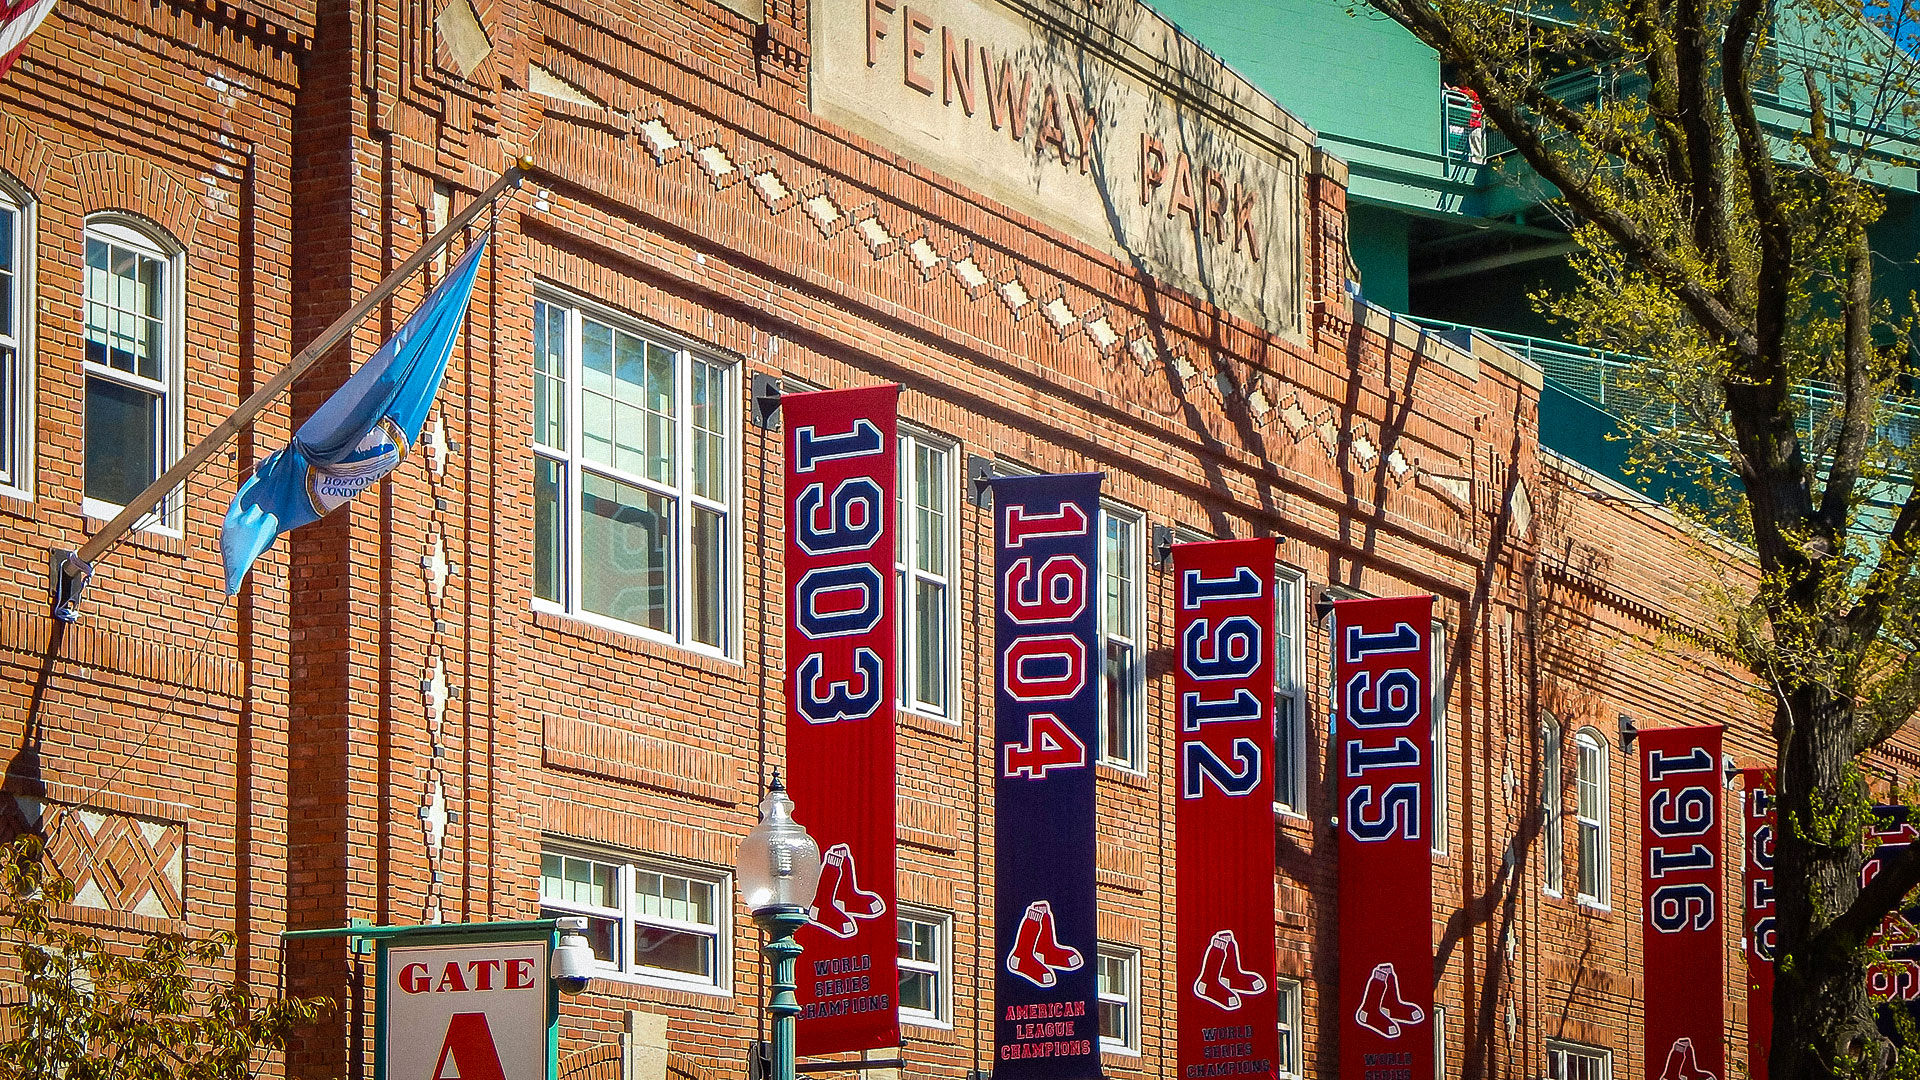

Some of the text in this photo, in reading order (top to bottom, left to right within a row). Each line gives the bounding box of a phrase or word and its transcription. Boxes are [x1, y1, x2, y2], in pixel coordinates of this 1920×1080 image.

[866, 0, 1259, 262] FENWAY PARK
[795, 418, 884, 725] 1903
[1004, 501, 1088, 780] 1904
[1183, 566, 1263, 799] 1912
[1346, 622, 1420, 841] 1915
[1649, 747, 1714, 934] 1916
[814, 954, 871, 976] WORLD
[398, 958, 536, 995] GATE
[815, 975, 870, 997] SERIES
[1005, 1001, 1085, 1021] AMERICAN
[1016, 1021, 1075, 1040] LEAGUE
[1202, 1025, 1253, 1042] WORLD
[432, 1012, 507, 1080] A
[1001, 1039, 1091, 1061] CHAMPIONS
[1203, 1042, 1252, 1060] SERIES
[1187, 1058, 1270, 1078] CHAMPIONS
[1363, 1051, 1412, 1066] WORLD
